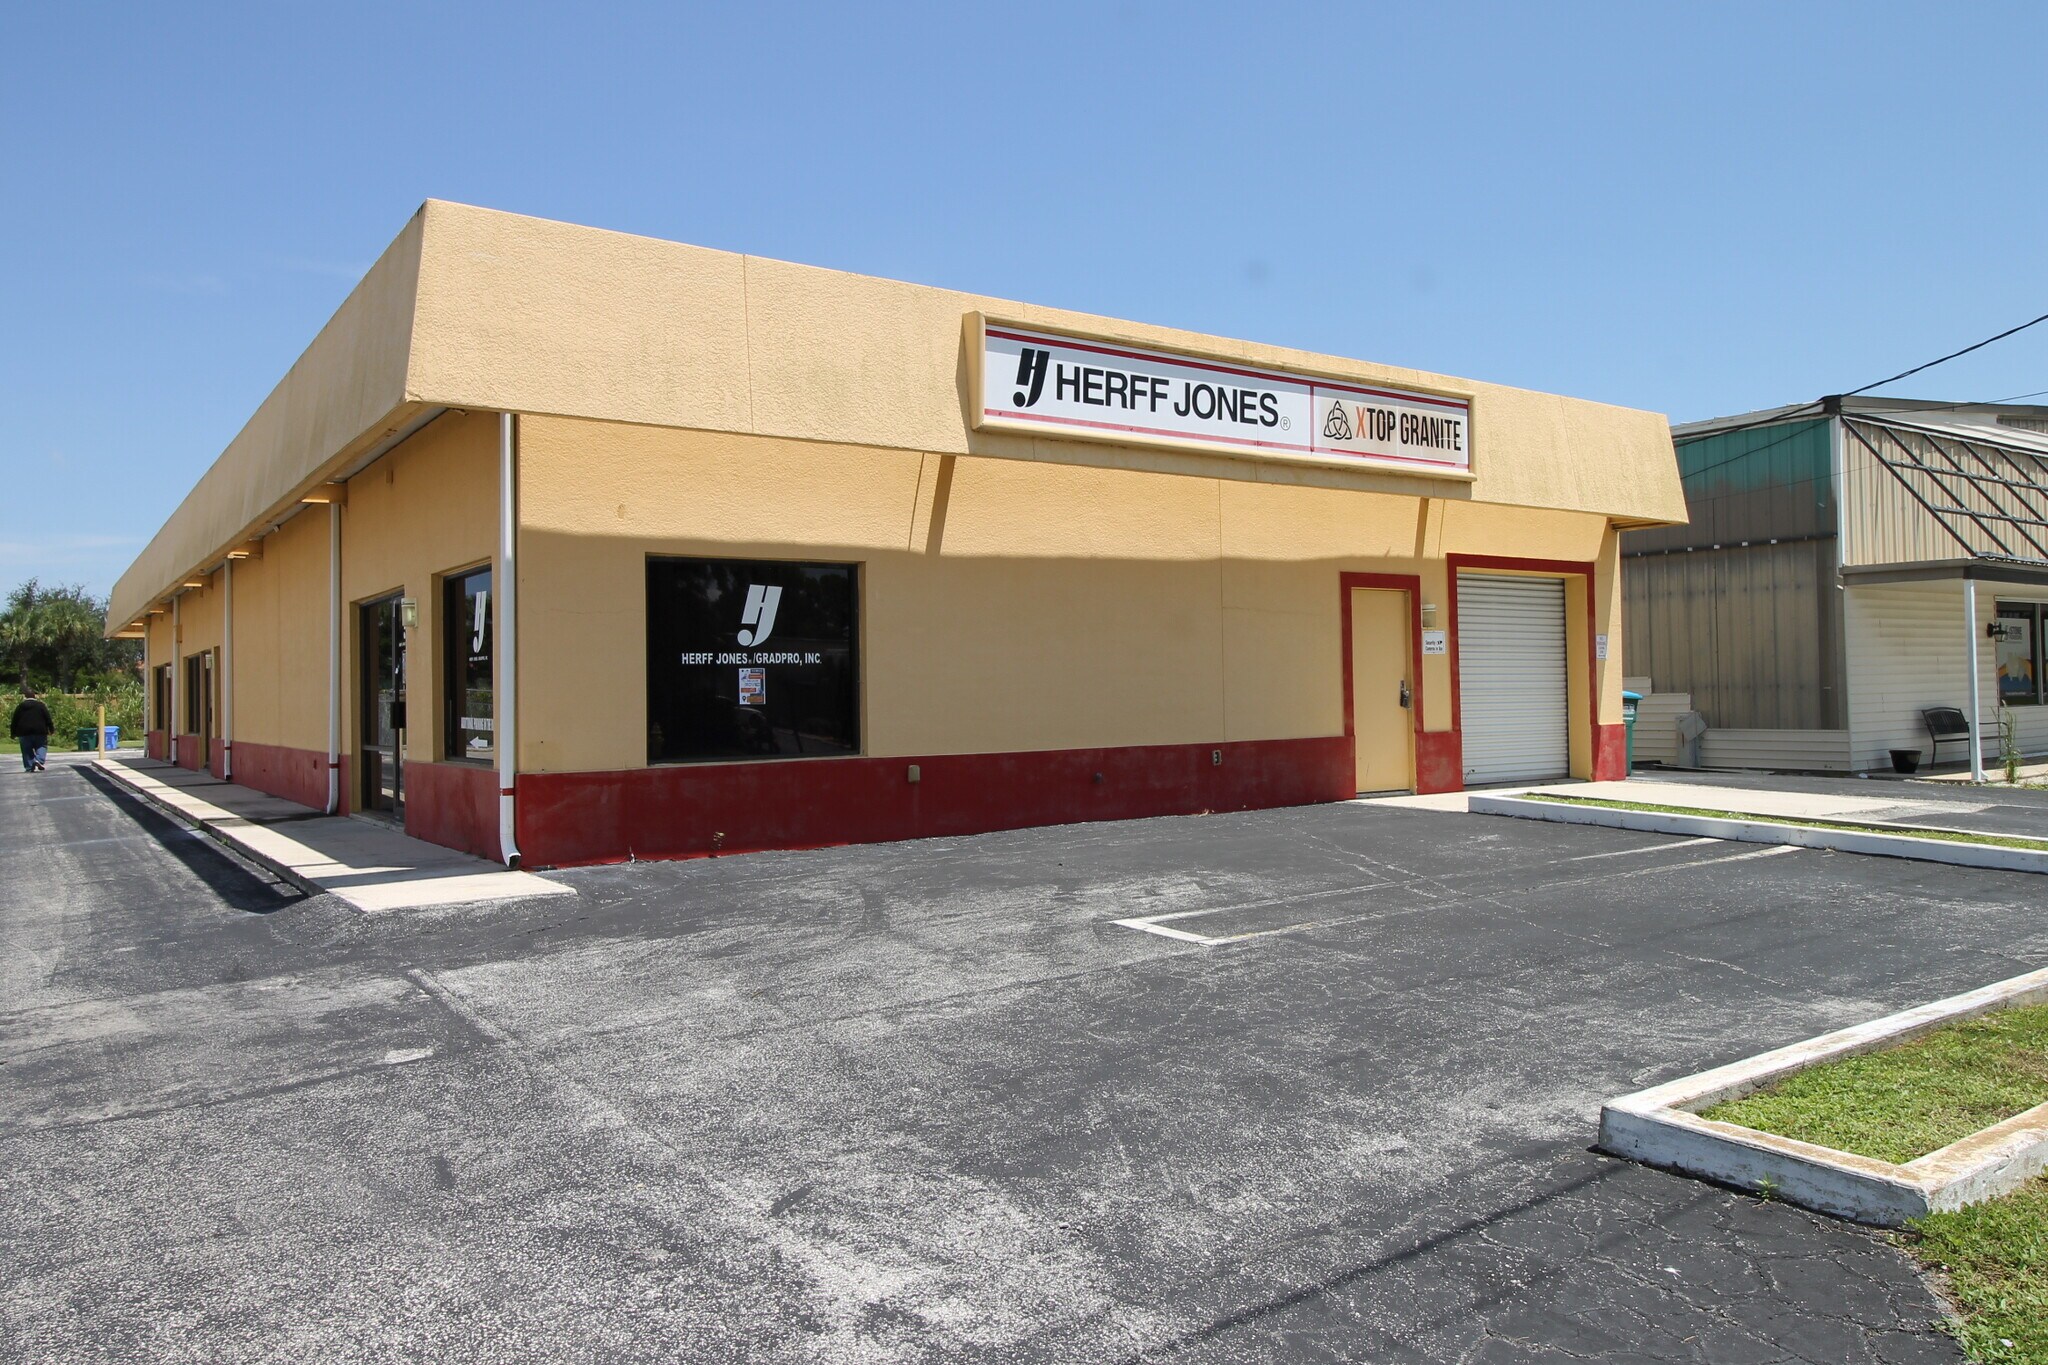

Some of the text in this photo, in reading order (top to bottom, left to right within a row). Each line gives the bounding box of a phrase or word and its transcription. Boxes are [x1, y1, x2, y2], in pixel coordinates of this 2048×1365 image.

[1056, 363, 1279, 428] HERFF JONES
[1355, 406, 1462, 451] XTOP GRANITE
[681, 652, 713, 665] HERFF
[716, 652, 748, 665] JONES
